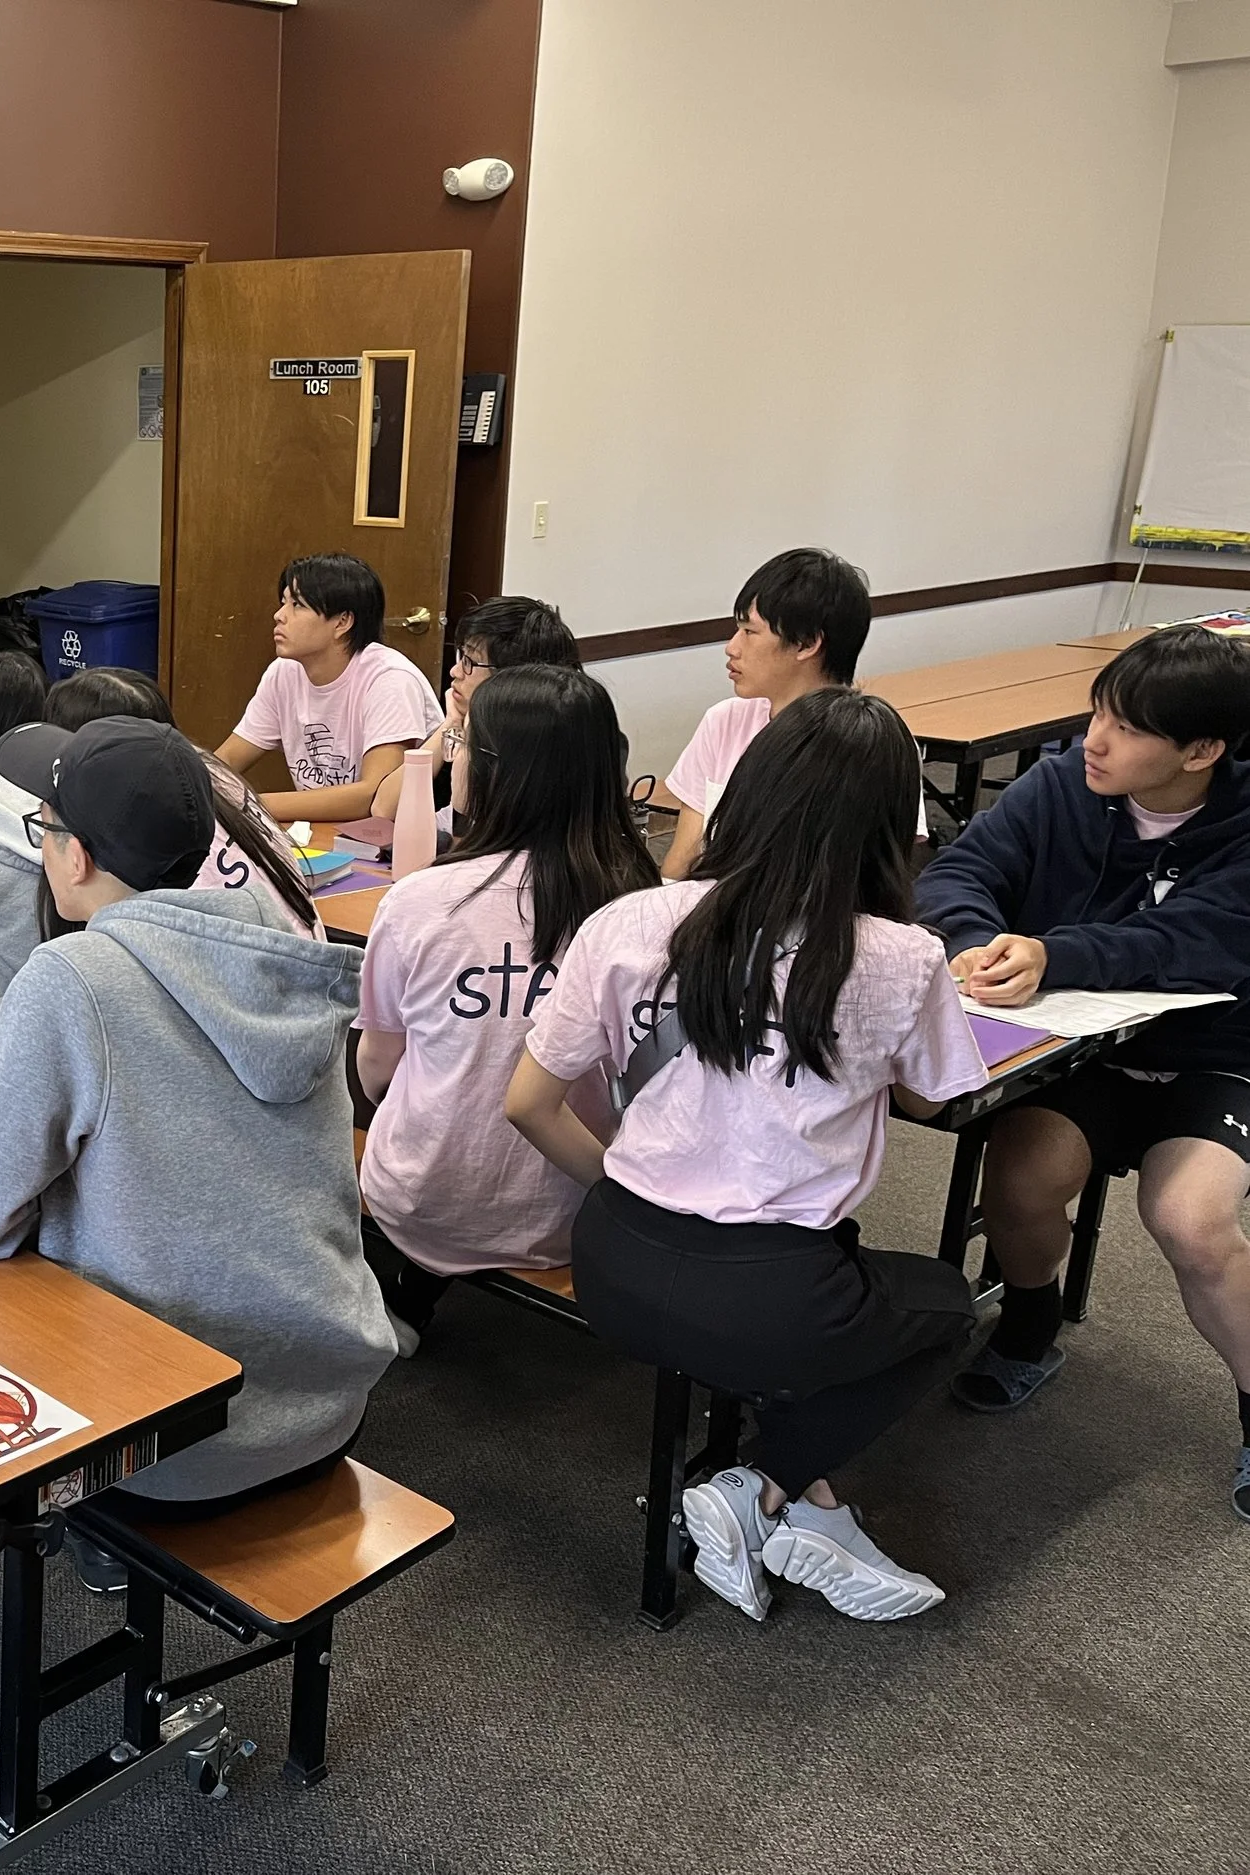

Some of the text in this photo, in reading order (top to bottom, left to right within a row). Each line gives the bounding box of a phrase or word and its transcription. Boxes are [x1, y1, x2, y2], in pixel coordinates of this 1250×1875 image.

[275, 361, 356, 375] Lunch Room
[304, 379, 329, 395] 105
[58, 657, 87, 670] RECYCLE
